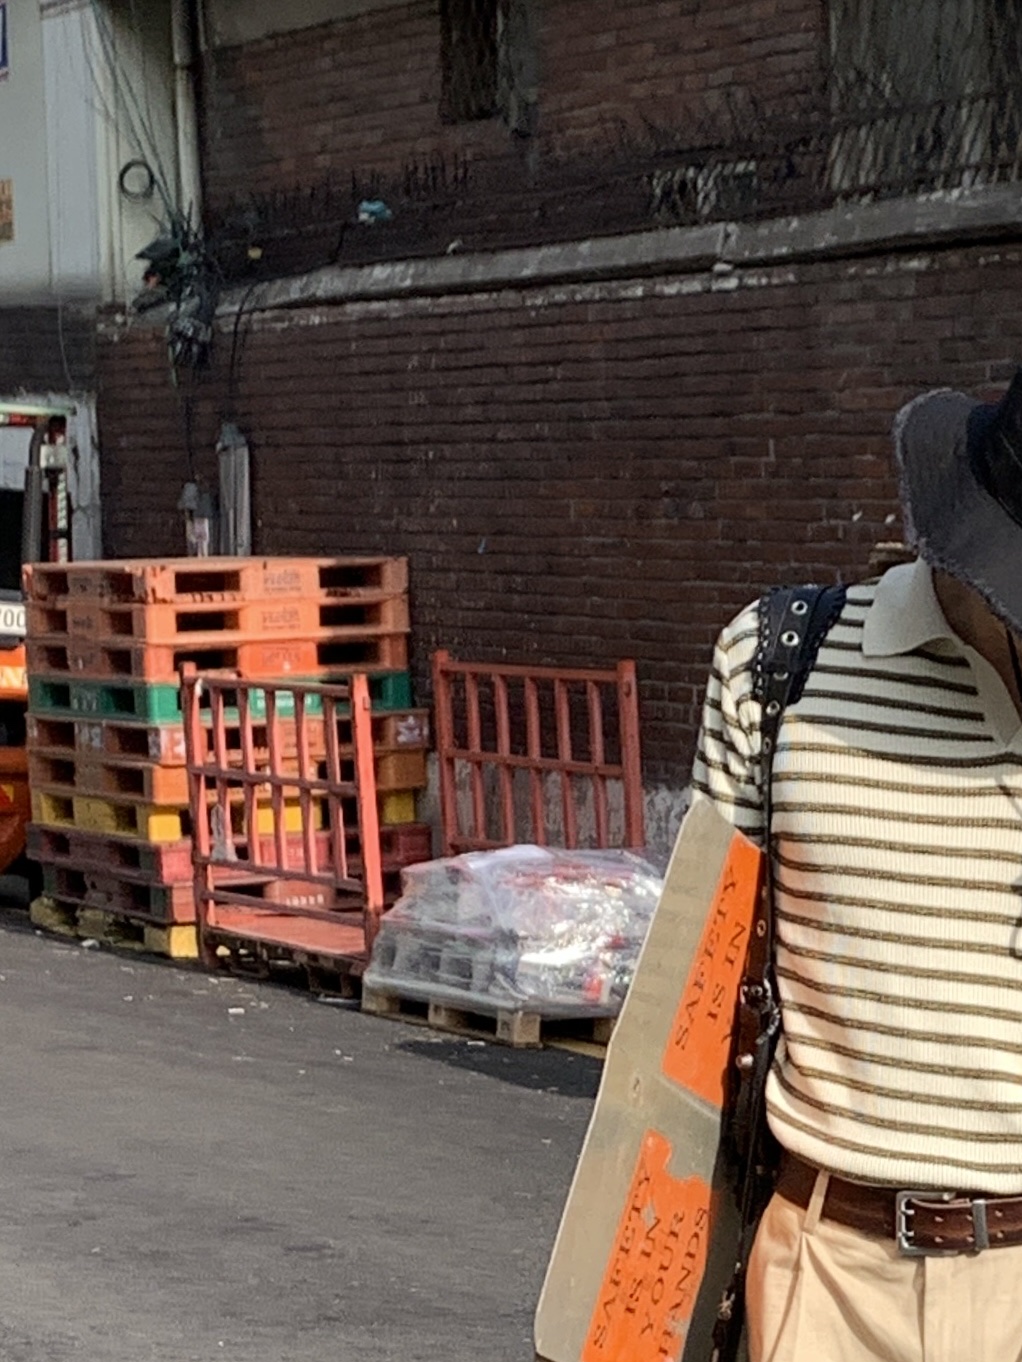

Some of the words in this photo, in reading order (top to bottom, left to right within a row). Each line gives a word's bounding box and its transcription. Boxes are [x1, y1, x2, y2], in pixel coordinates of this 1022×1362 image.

[674, 866, 737, 1050] SAFETY
[707, 983, 726, 1021] IS
[725, 921, 747, 968] IN
[593, 1157, 650, 1349] SAFETY
[624, 1277, 643, 1315] IS
[640, 1216, 661, 1259] IN
[640, 1211, 684, 1336] YOUR
[658, 1207, 707, 1356] HANDS
